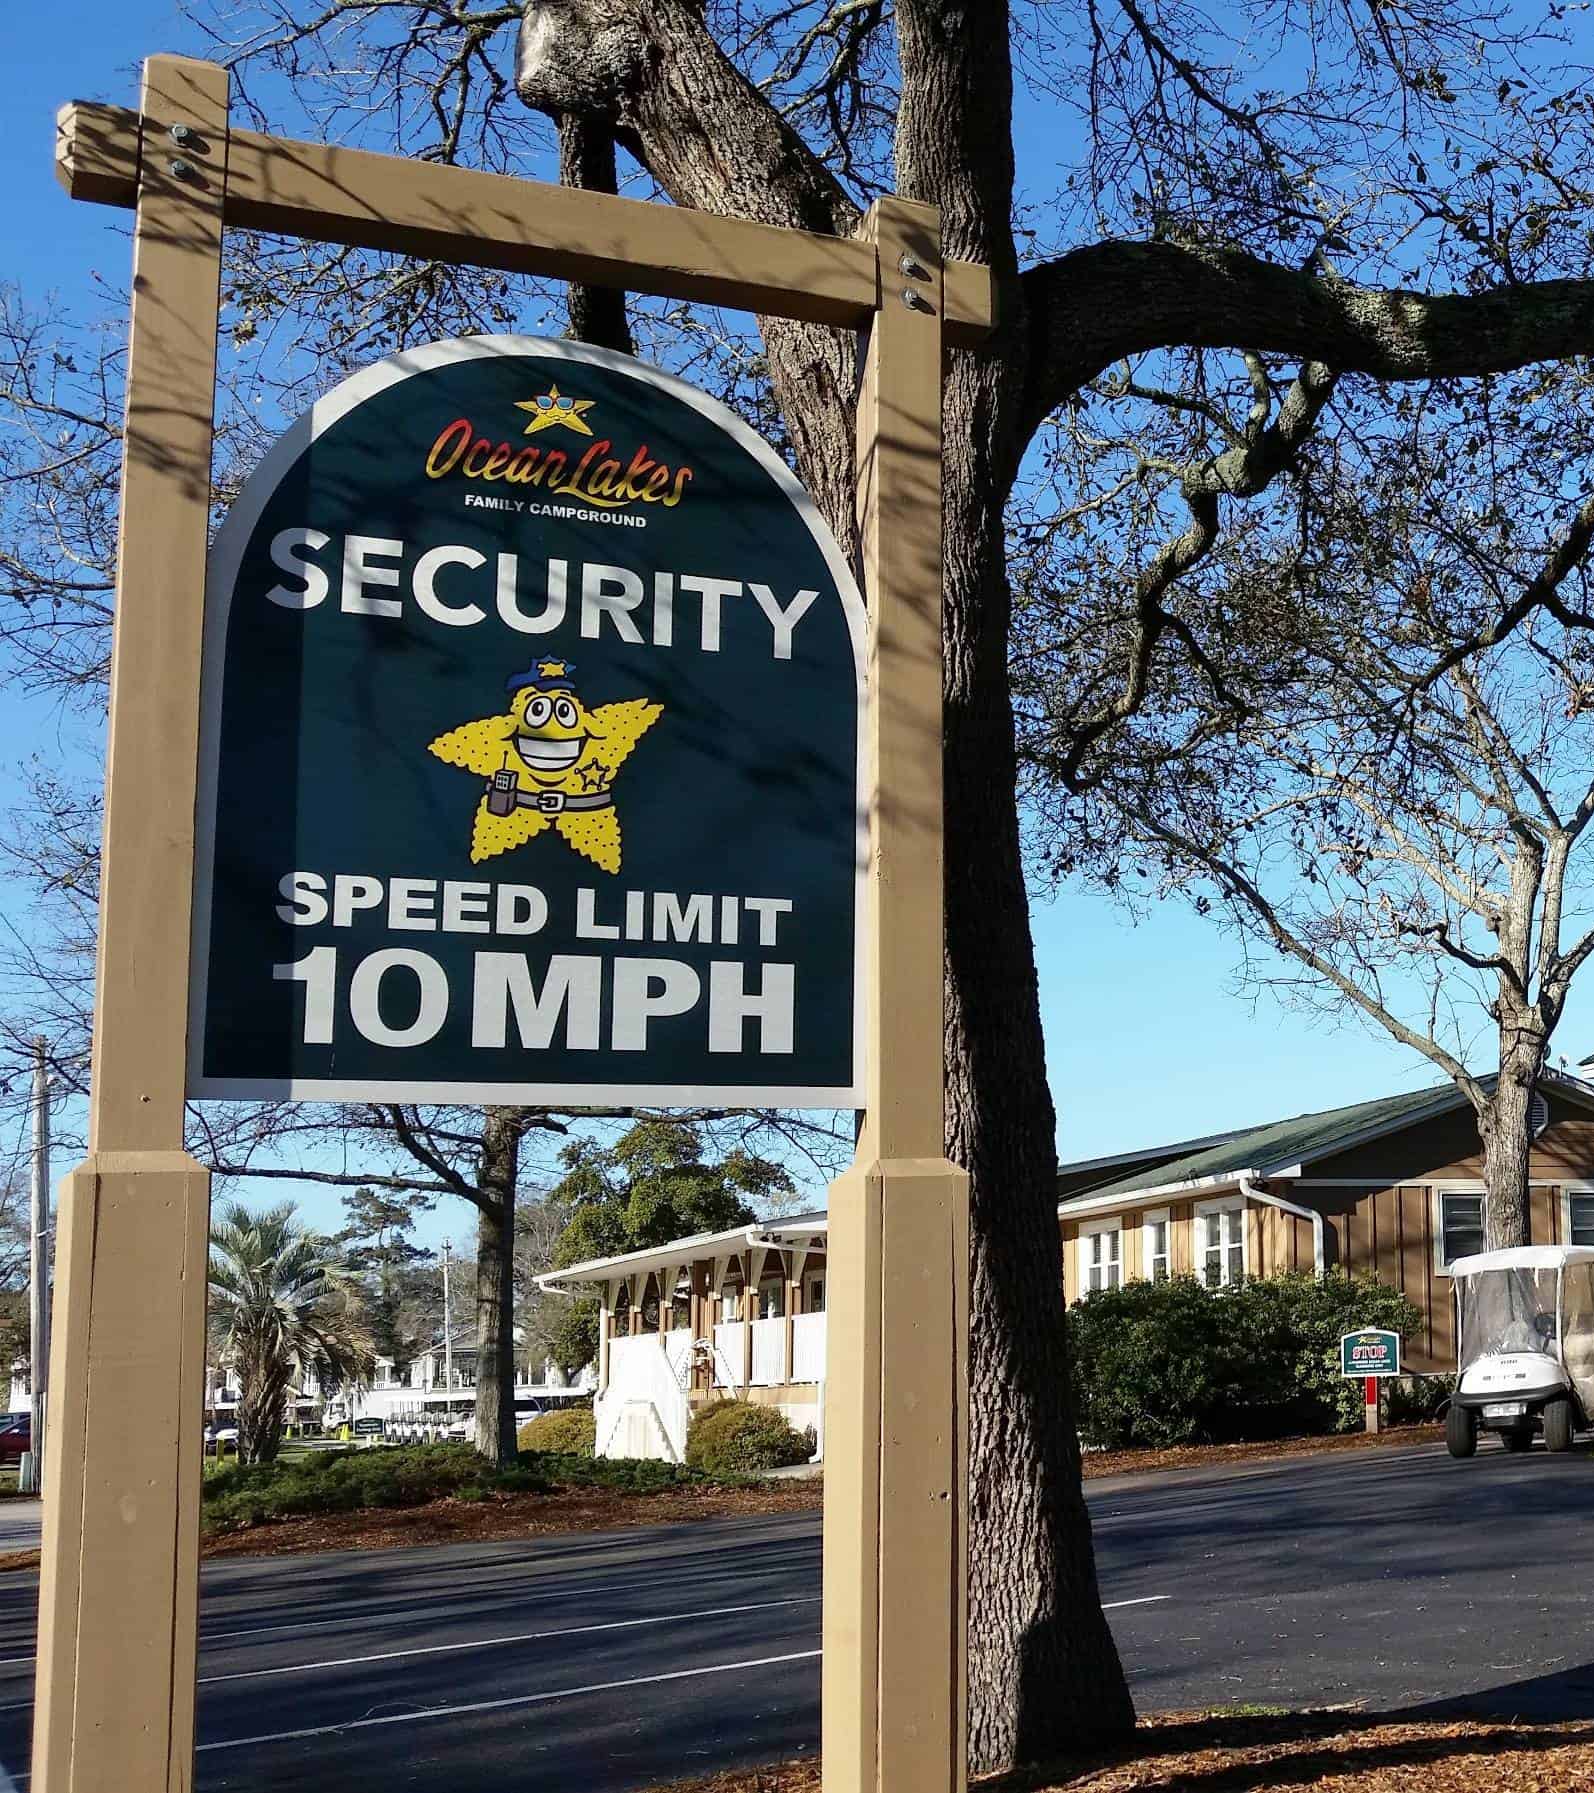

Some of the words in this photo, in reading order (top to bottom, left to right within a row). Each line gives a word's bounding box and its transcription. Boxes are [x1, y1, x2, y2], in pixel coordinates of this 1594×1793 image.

[425, 418, 568, 487] Ocean
[552, 439, 693, 508] Lakes
[464, 494, 525, 513] FAMILY
[529, 502, 648, 529] CAMPGROUND
[265, 527, 821, 660] SECURITY
[275, 871, 549, 936] SPEED
[575, 887, 793, 947] LIMIT
[272, 945, 450, 1048] 10
[471, 951, 796, 1054] MPH
[1352, 1345, 1387, 1360] STOP
